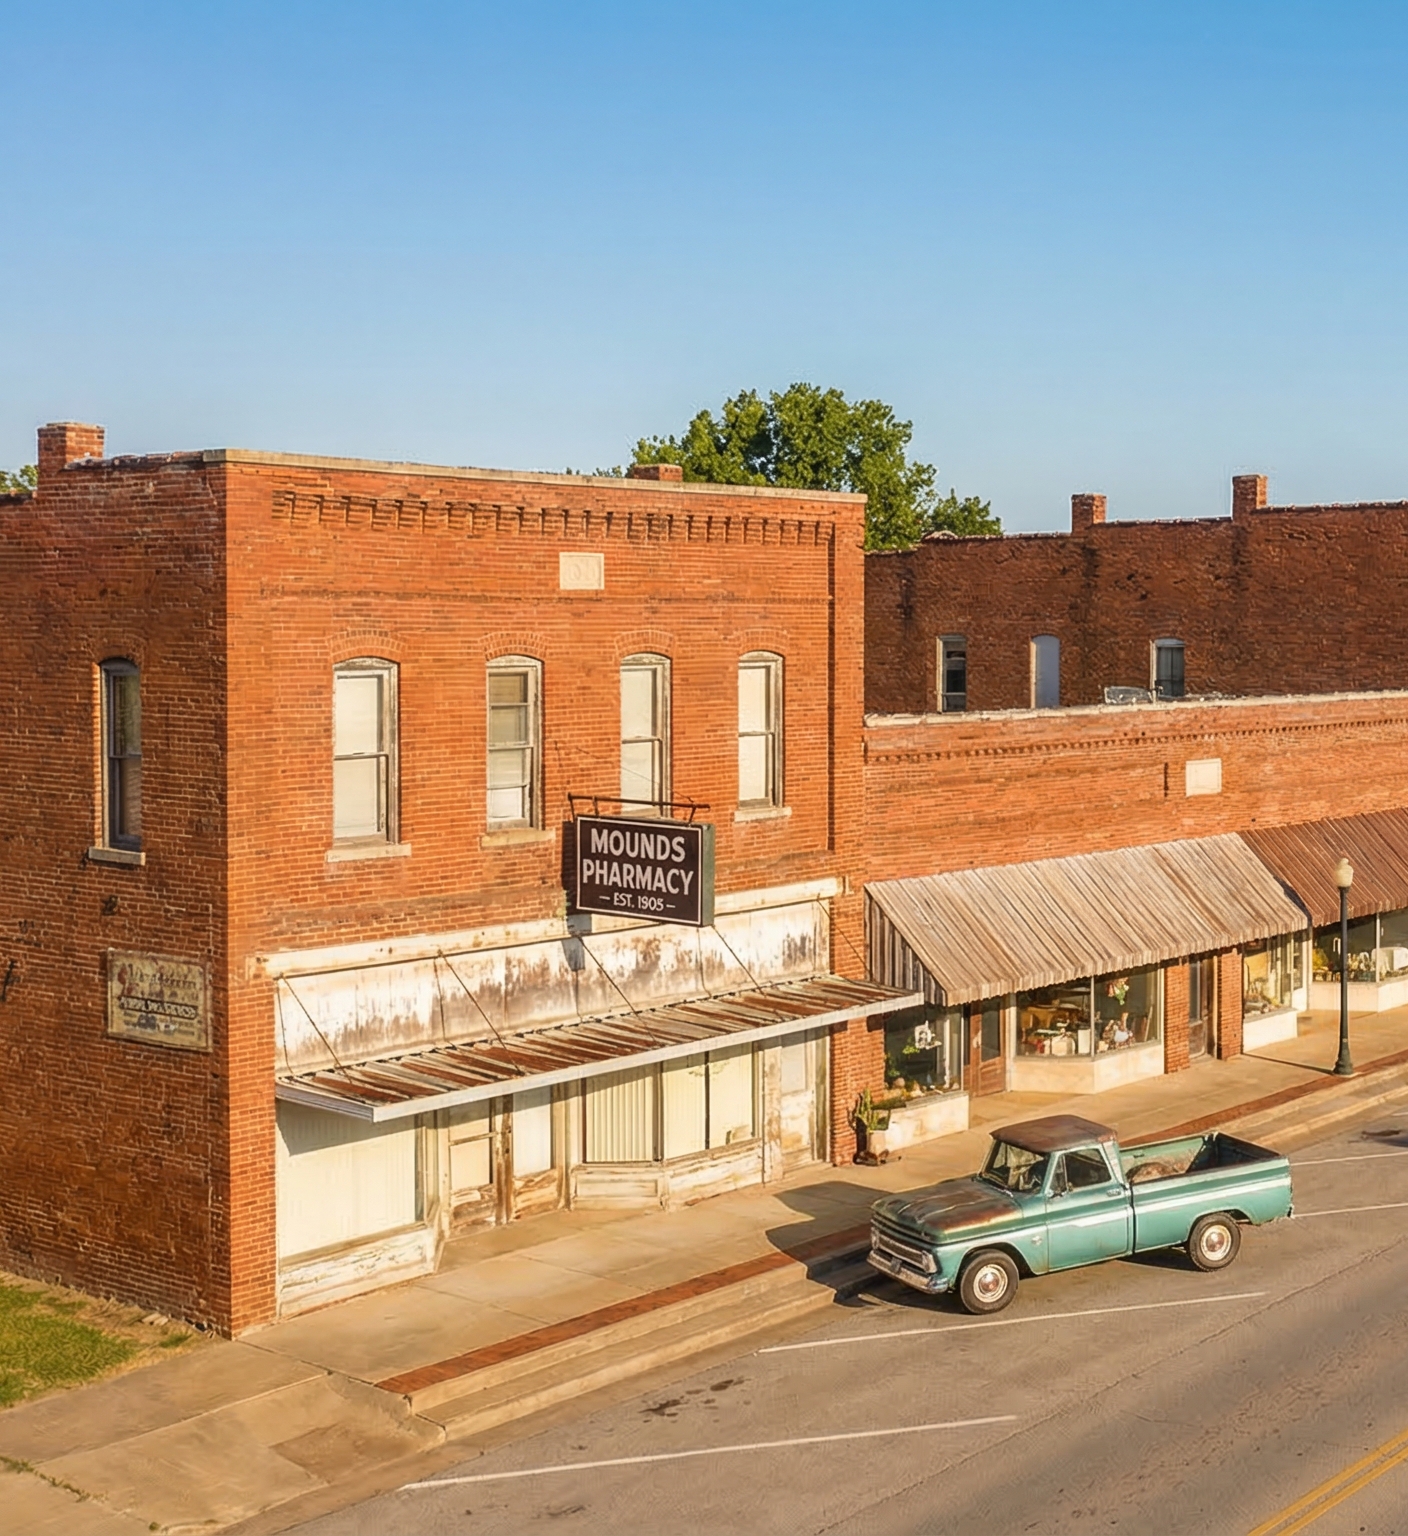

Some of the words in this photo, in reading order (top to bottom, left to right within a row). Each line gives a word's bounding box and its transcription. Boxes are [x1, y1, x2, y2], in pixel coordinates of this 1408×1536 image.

[591, 828, 686, 862] MOUNDS
[582, 858, 694, 895] PHARMACY
[613, 892, 635, 908] EST.
[637, 895, 664, 911] 1905
